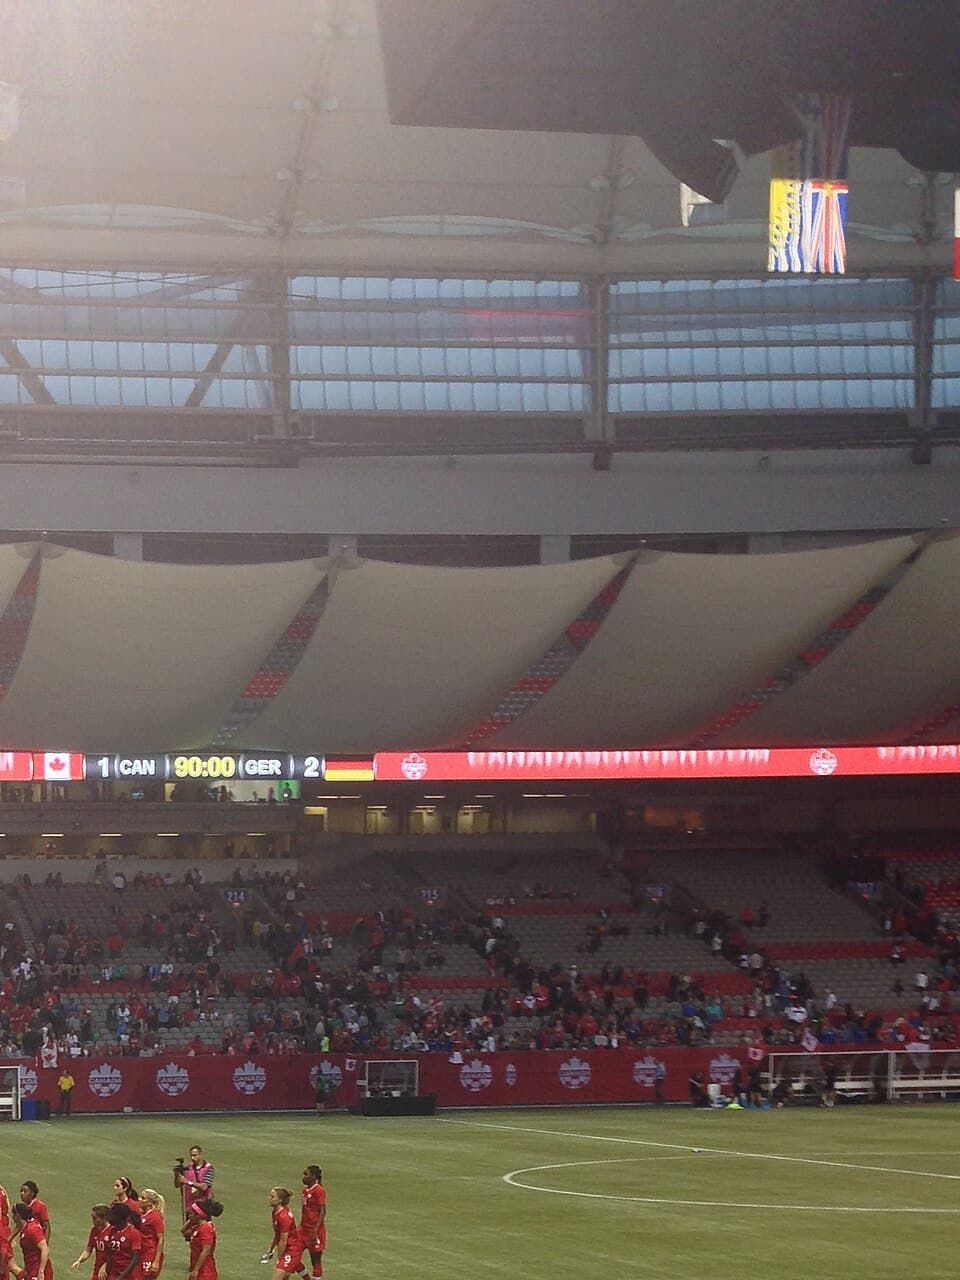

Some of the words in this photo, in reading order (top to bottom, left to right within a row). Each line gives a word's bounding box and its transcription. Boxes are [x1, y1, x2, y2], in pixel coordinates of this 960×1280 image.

[98, 757, 109, 777] 1
[119, 759, 156, 776] CAN
[174, 756, 236, 778] 90:00
[245, 759, 282, 776] GER
[304, 756, 319, 778] 2
[284, 1254, 292, 1264] 9
